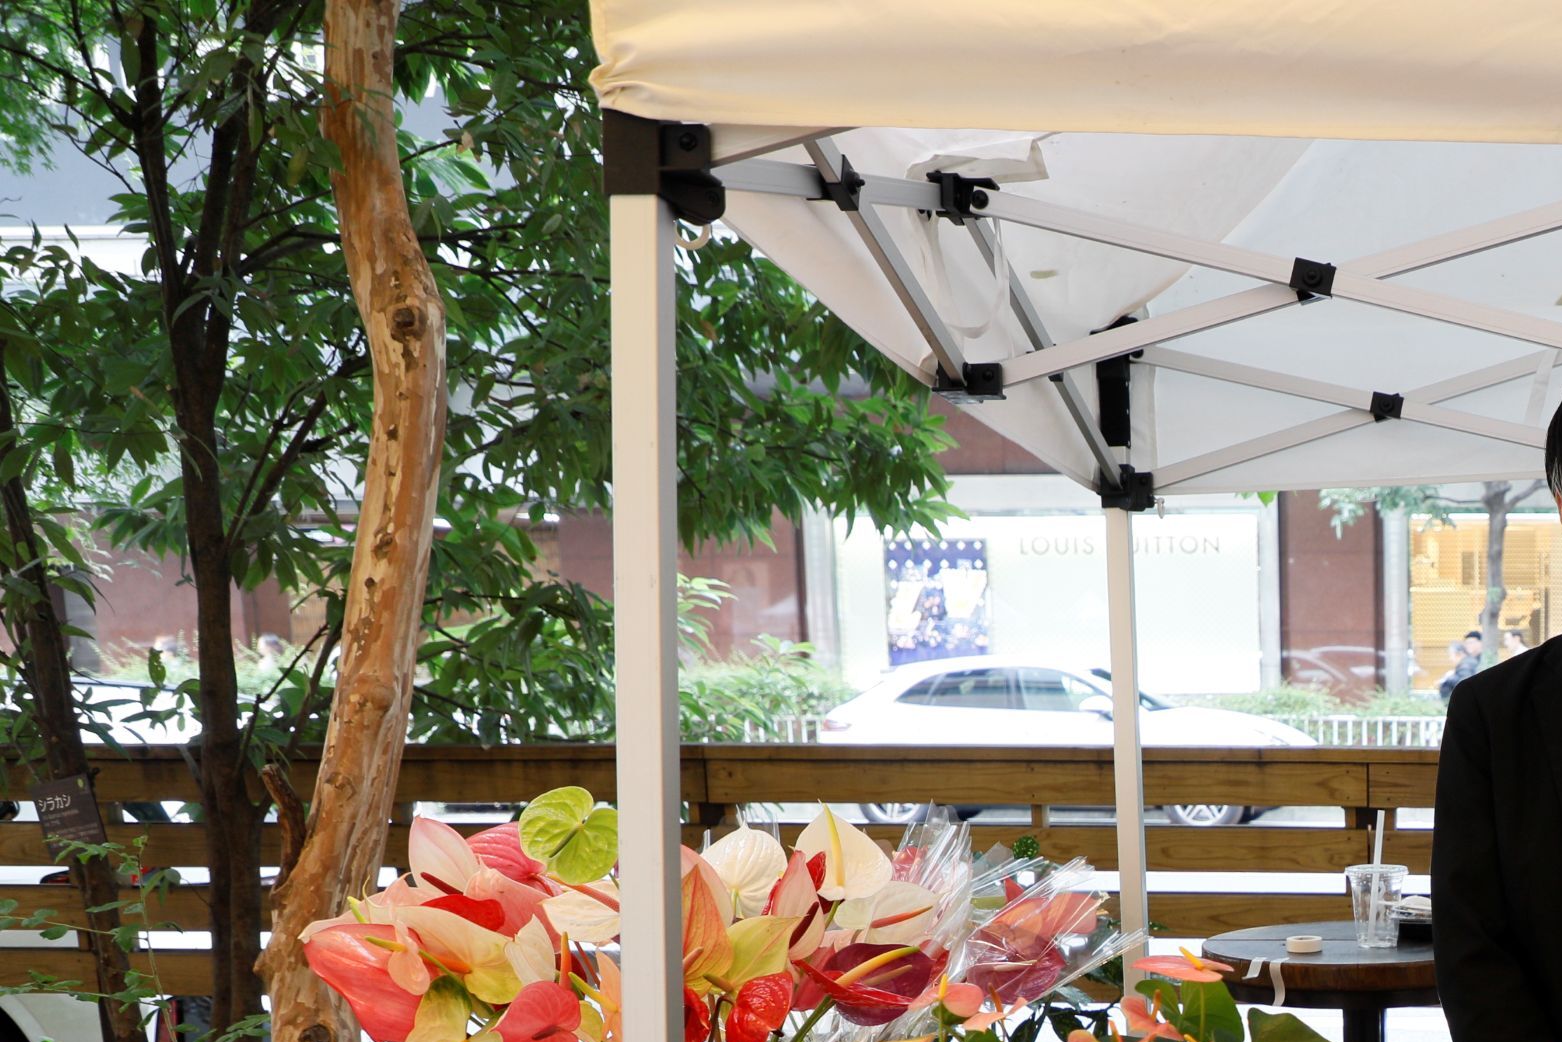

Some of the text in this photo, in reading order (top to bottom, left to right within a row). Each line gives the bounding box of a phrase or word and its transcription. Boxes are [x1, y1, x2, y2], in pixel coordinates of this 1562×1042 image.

[1019, 535, 1220, 556] LOUIS ITTON
[38, 794, 71, 812] シラカシ
